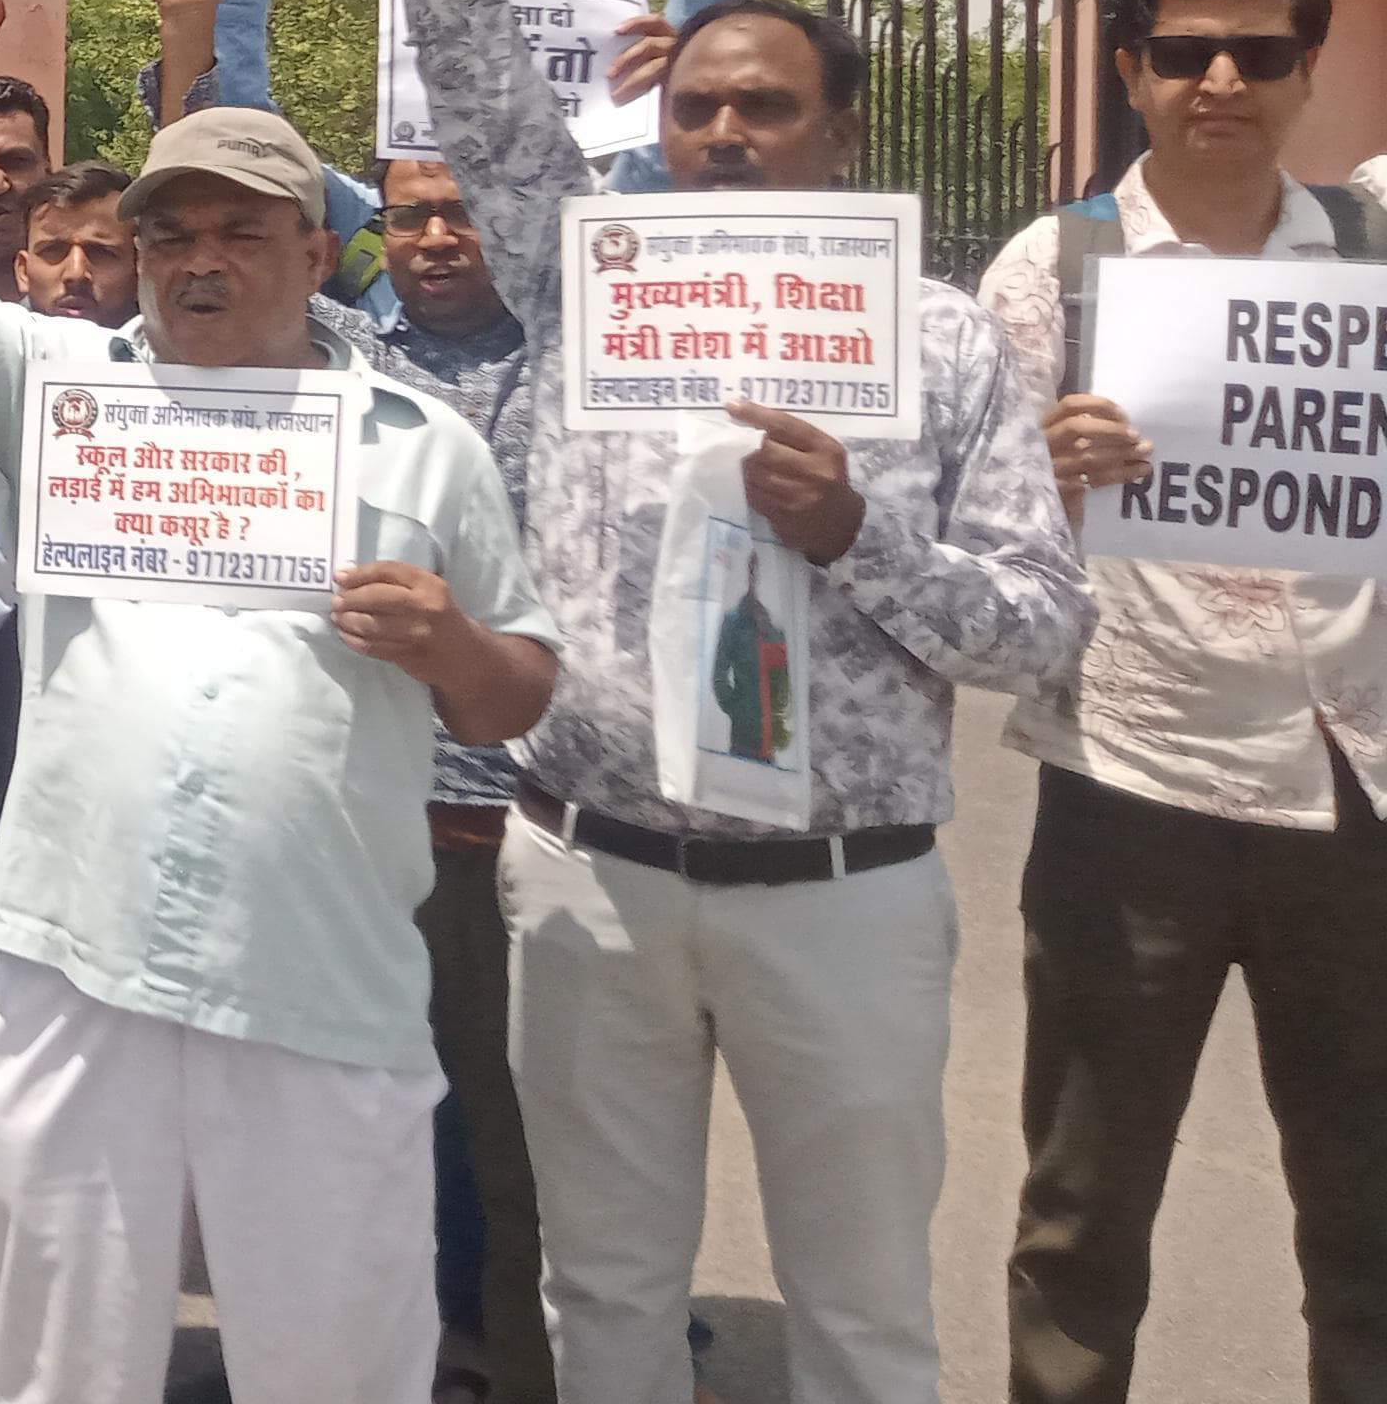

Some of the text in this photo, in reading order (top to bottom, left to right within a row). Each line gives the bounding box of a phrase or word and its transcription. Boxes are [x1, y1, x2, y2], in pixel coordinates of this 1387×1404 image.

[545, 2, 574, 27] दो
[544, 36, 598, 83] तो
[609, 270, 865, 320] मुख्यमंत्री, शिक्षा
[602, 323, 874, 365] मंत्री होश में आओ
[76, 441, 286, 477] स्कूल और सरकार की
[48, 468, 324, 511] लड़ाई में हम अभिभावकों का
[114, 512, 152, 535] क्या
[158, 514, 209, 546] कसूर
[210, 511, 229, 539] है
[41, 533, 326, 584] हेल्पलाइन नंबर 9772377755
